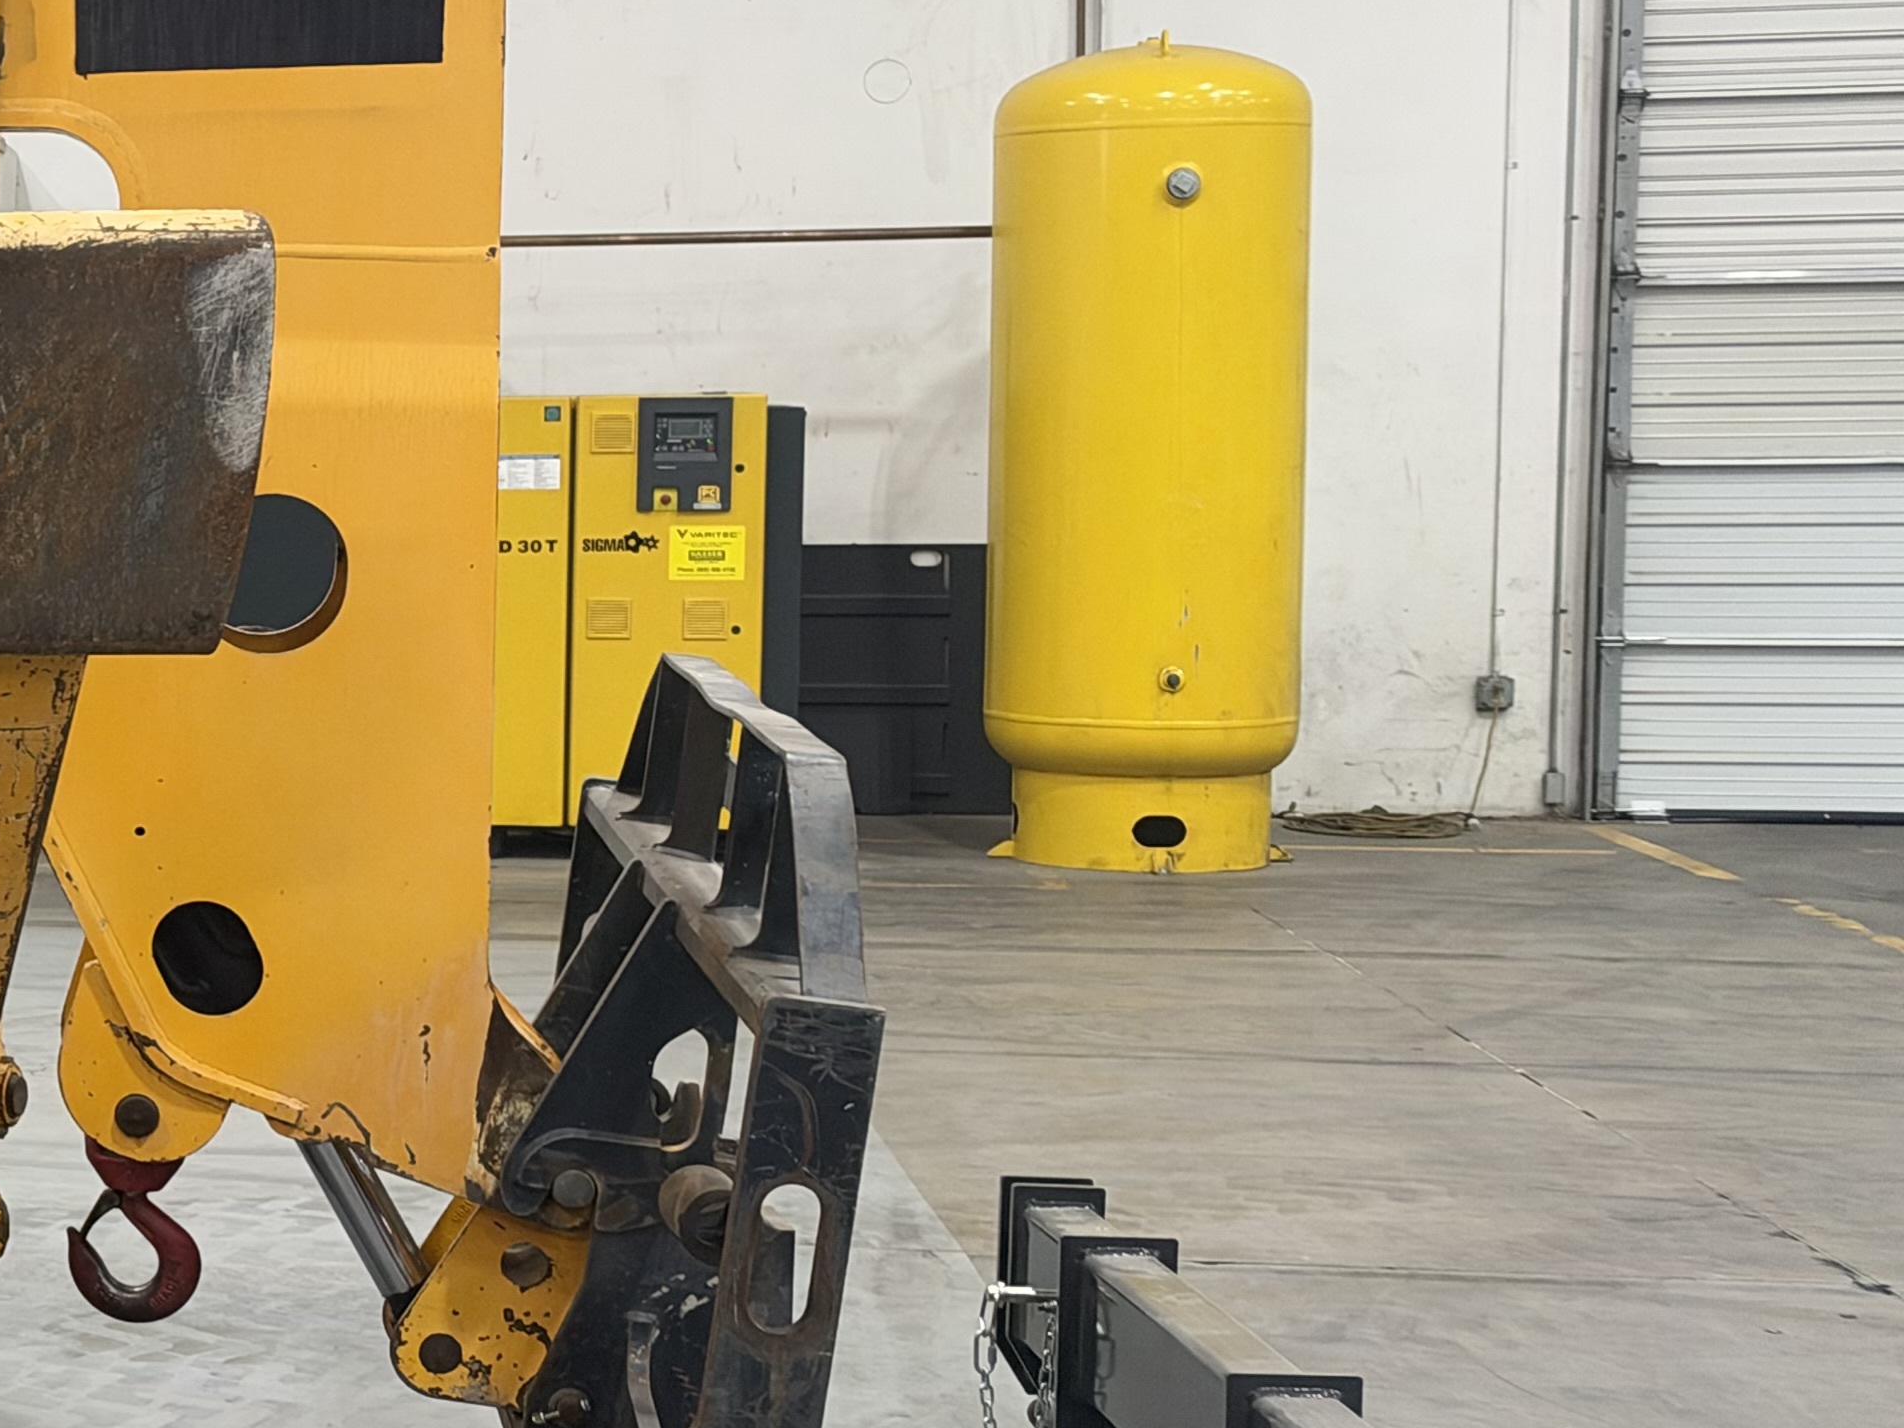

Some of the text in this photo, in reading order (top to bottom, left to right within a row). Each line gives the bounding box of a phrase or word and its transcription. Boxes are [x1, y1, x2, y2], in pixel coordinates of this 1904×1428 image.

[689, 531, 738, 539] VARITEC
[517, 539, 542, 554] 30
[545, 539, 559, 553] T
[582, 538, 627, 553] SIGMA
